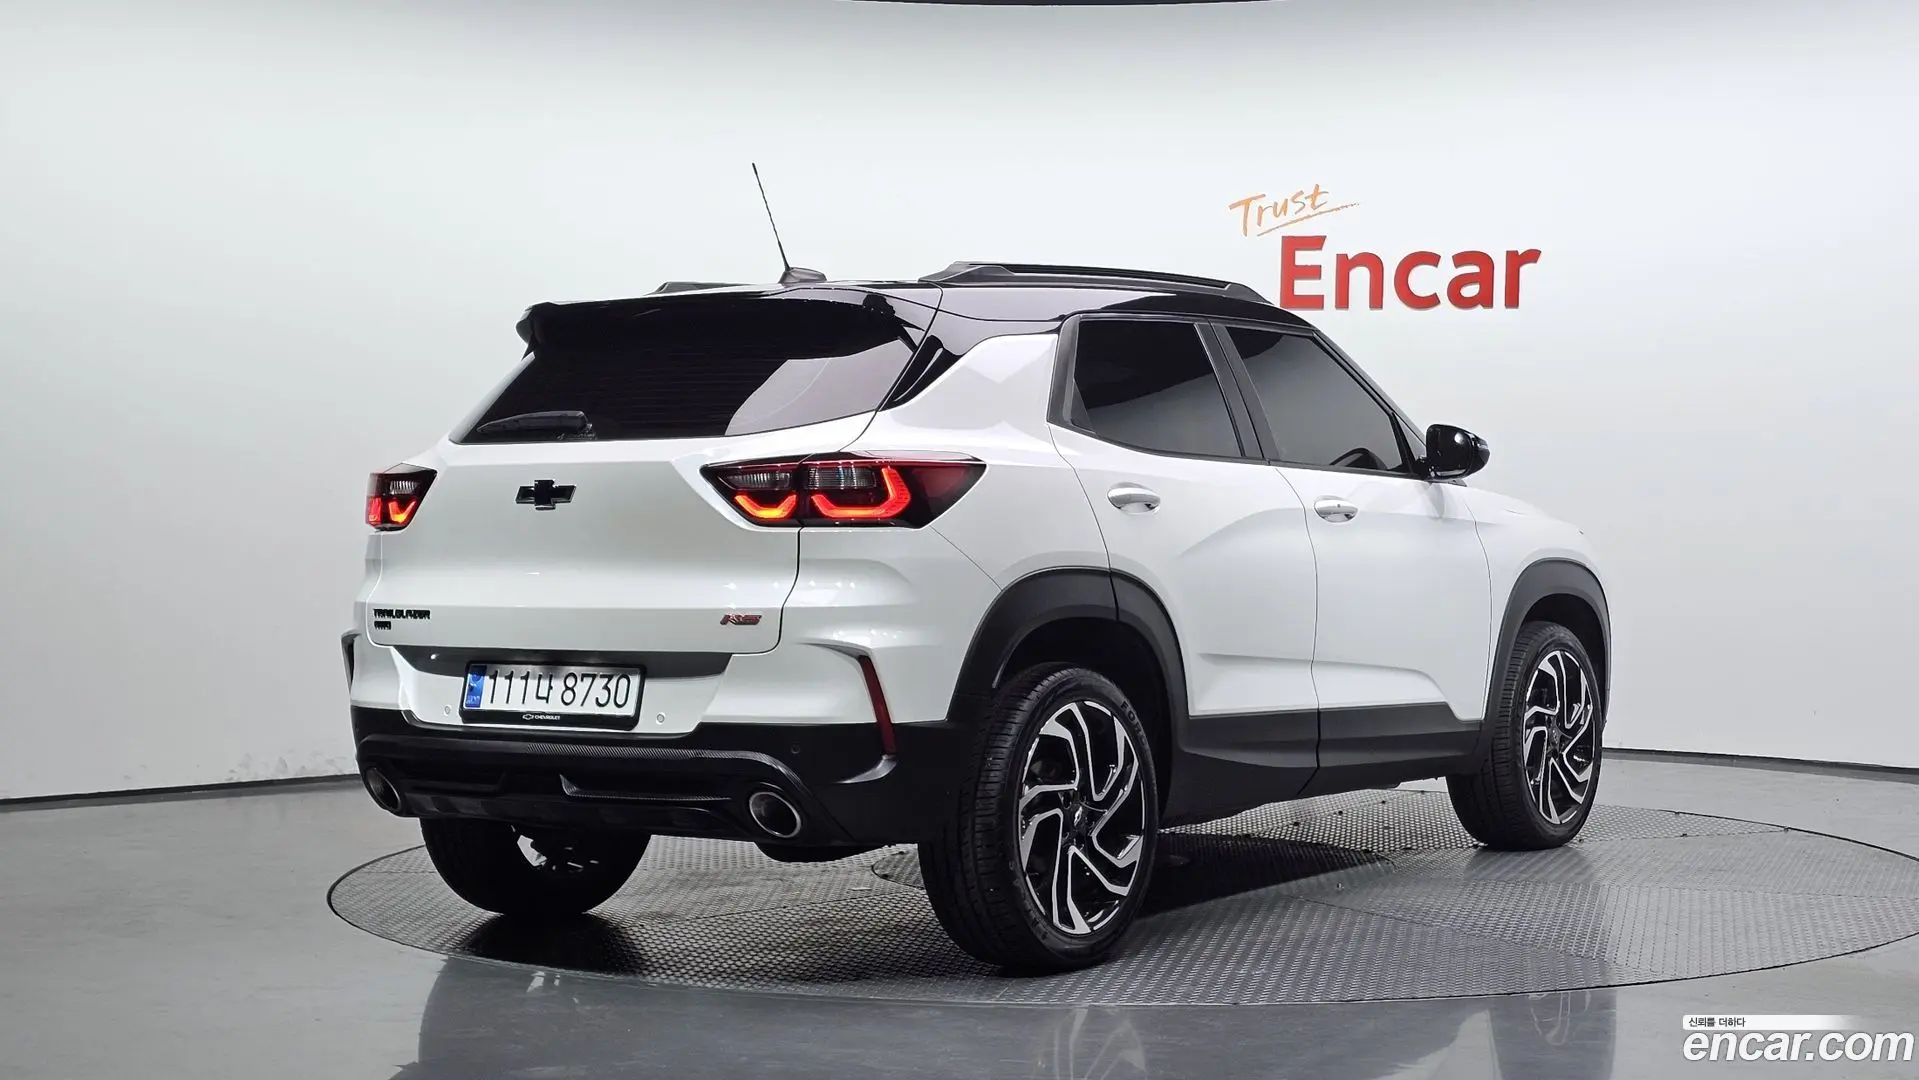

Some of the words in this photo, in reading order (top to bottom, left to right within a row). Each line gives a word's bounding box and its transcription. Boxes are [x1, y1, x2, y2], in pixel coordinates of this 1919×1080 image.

[1229, 183, 1329, 237] Trust
[1279, 235, 1542, 311] Encar
[560, 672, 631, 709] 8730
